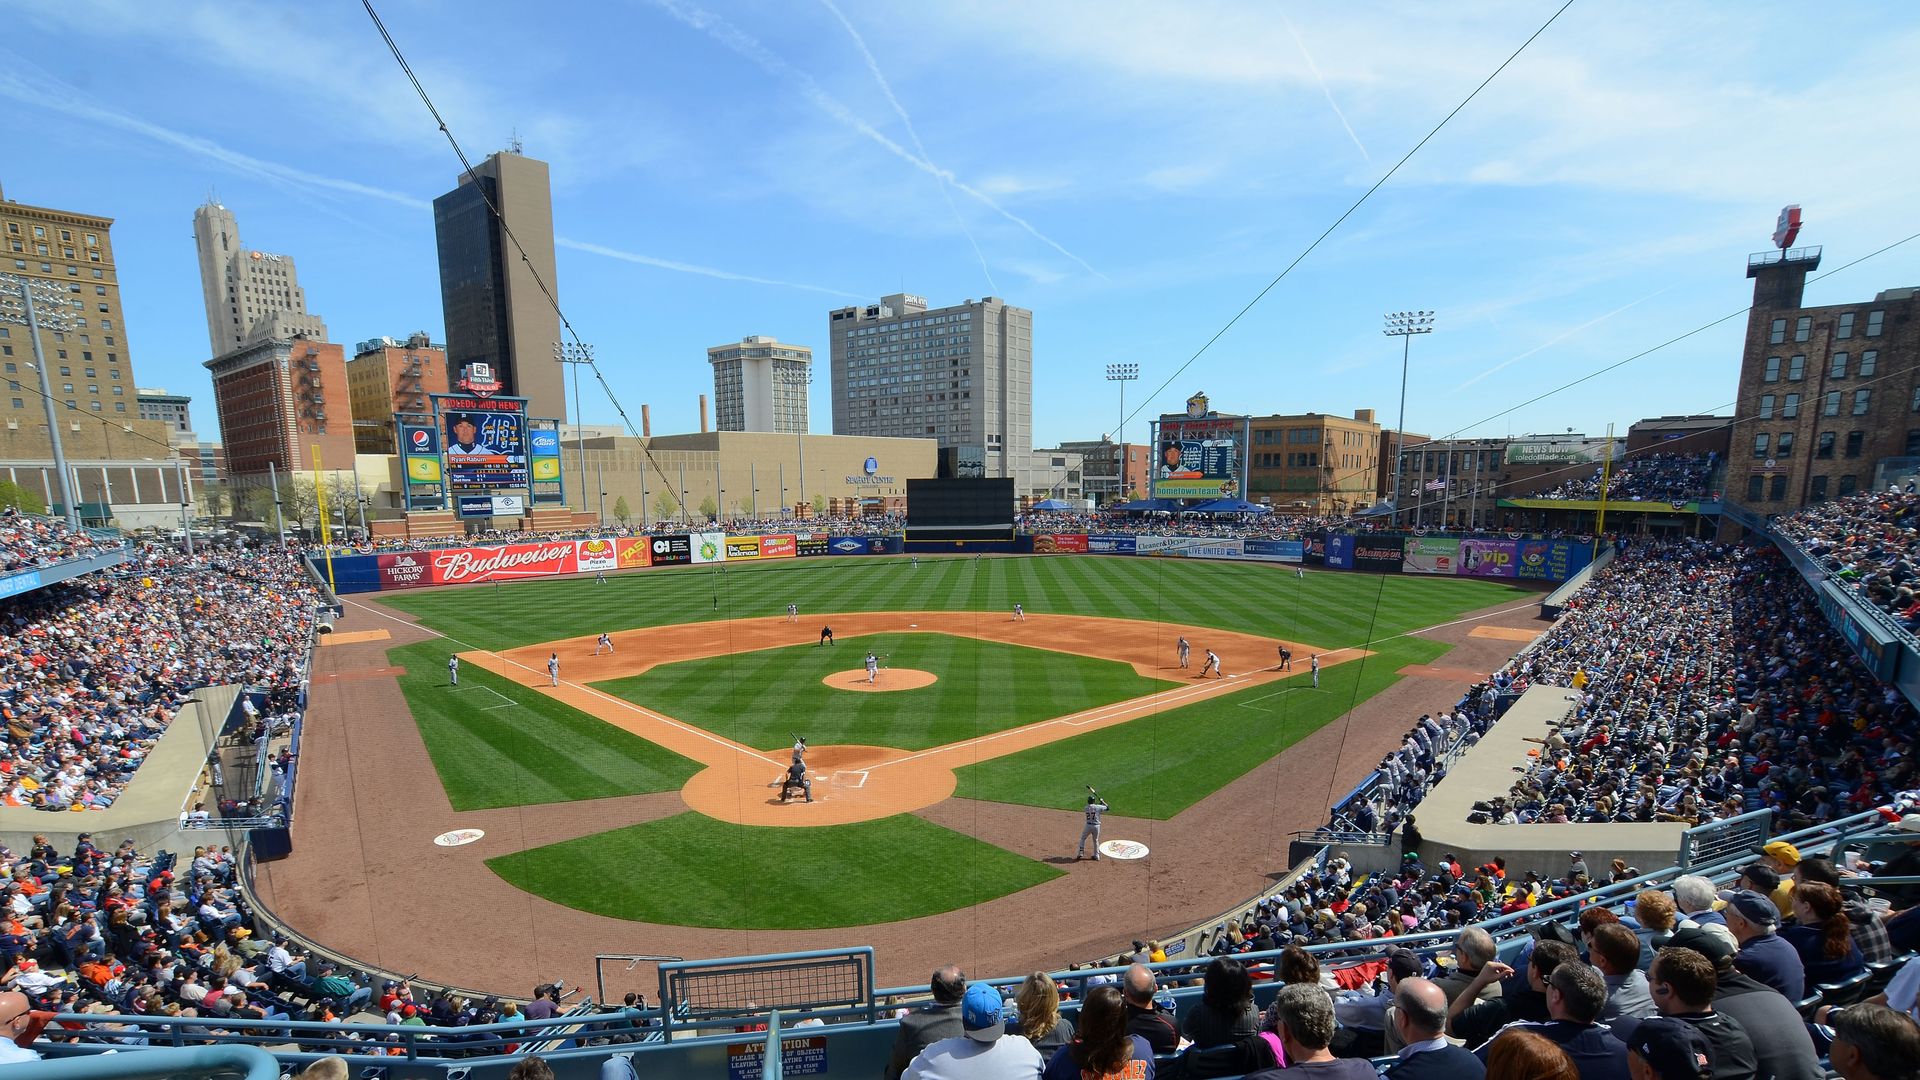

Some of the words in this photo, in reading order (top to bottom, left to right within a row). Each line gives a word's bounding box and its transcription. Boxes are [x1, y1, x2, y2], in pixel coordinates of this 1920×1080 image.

[262, 252, 281, 262] PNC
[445, 398, 476, 408] TOLEDO
[478, 400, 497, 409] MUD
[498, 400, 519, 410] HENS
[1522, 445, 1548, 454] NEWS
[1549, 445, 1570, 454] NOW
[1515, 453, 1576, 461] toledoBlade.com
[1156, 487, 1197, 495] hometown
[1198, 487, 1219, 495] team
[763, 538, 790, 546] SUBWAY
[1188, 547, 1202, 555] LIVE
[1202, 547, 1225, 555] UNITED
[1355, 547, 1402, 558] Champion
[434, 543, 573, 581] Budweiser
[1483, 549, 1509, 567] vip
[387, 565, 425, 575] HICKORY
[393, 573, 420, 581] FARMS
[1086, 812, 1096, 820] 27
[744, 1038, 812, 1053] ATTTION
[731, 1054, 756, 1062] PLEASE
[796, 1047, 824, 1056] OBJECTS
[731, 1060, 758, 1069] LEAVING
